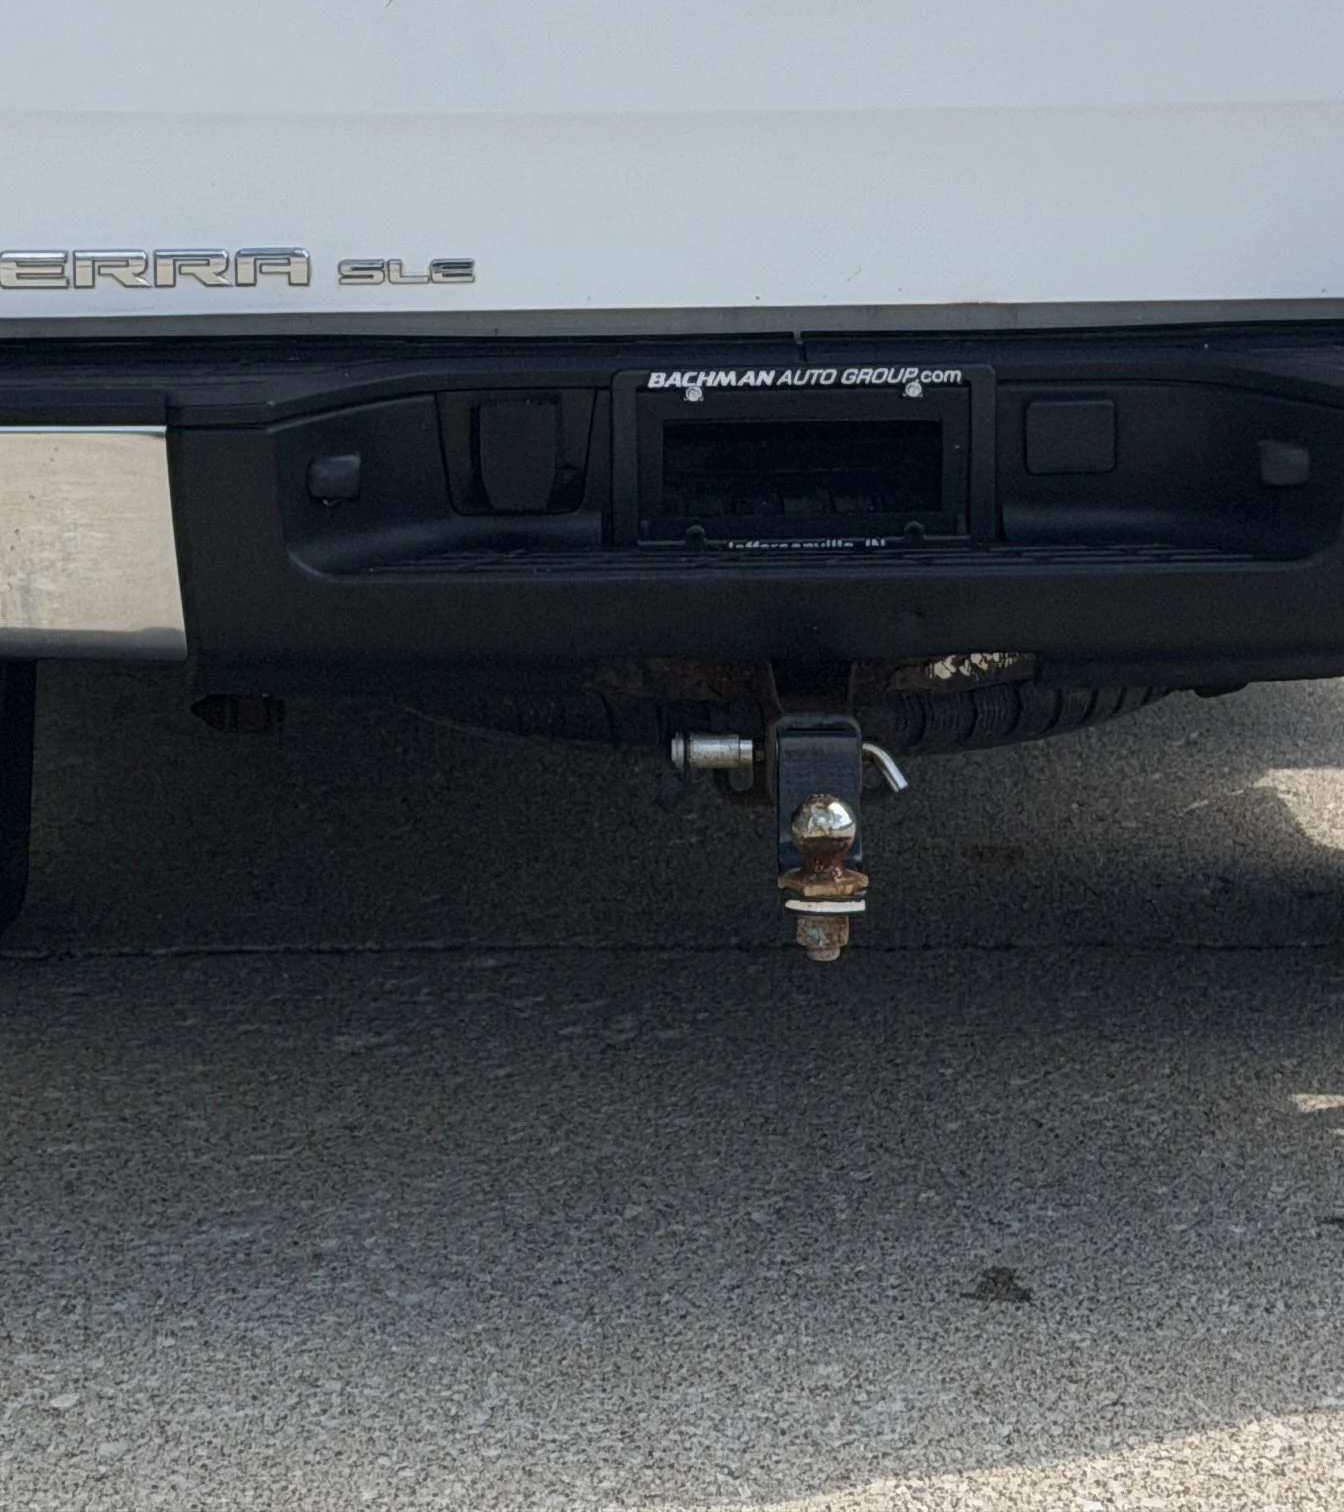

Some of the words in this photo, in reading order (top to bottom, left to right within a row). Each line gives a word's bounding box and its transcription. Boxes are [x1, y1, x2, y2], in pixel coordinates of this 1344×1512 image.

[338, 258, 476, 285] SLE
[647, 370, 775, 389] BACHMAN
[776, 369, 837, 386] AUTO
